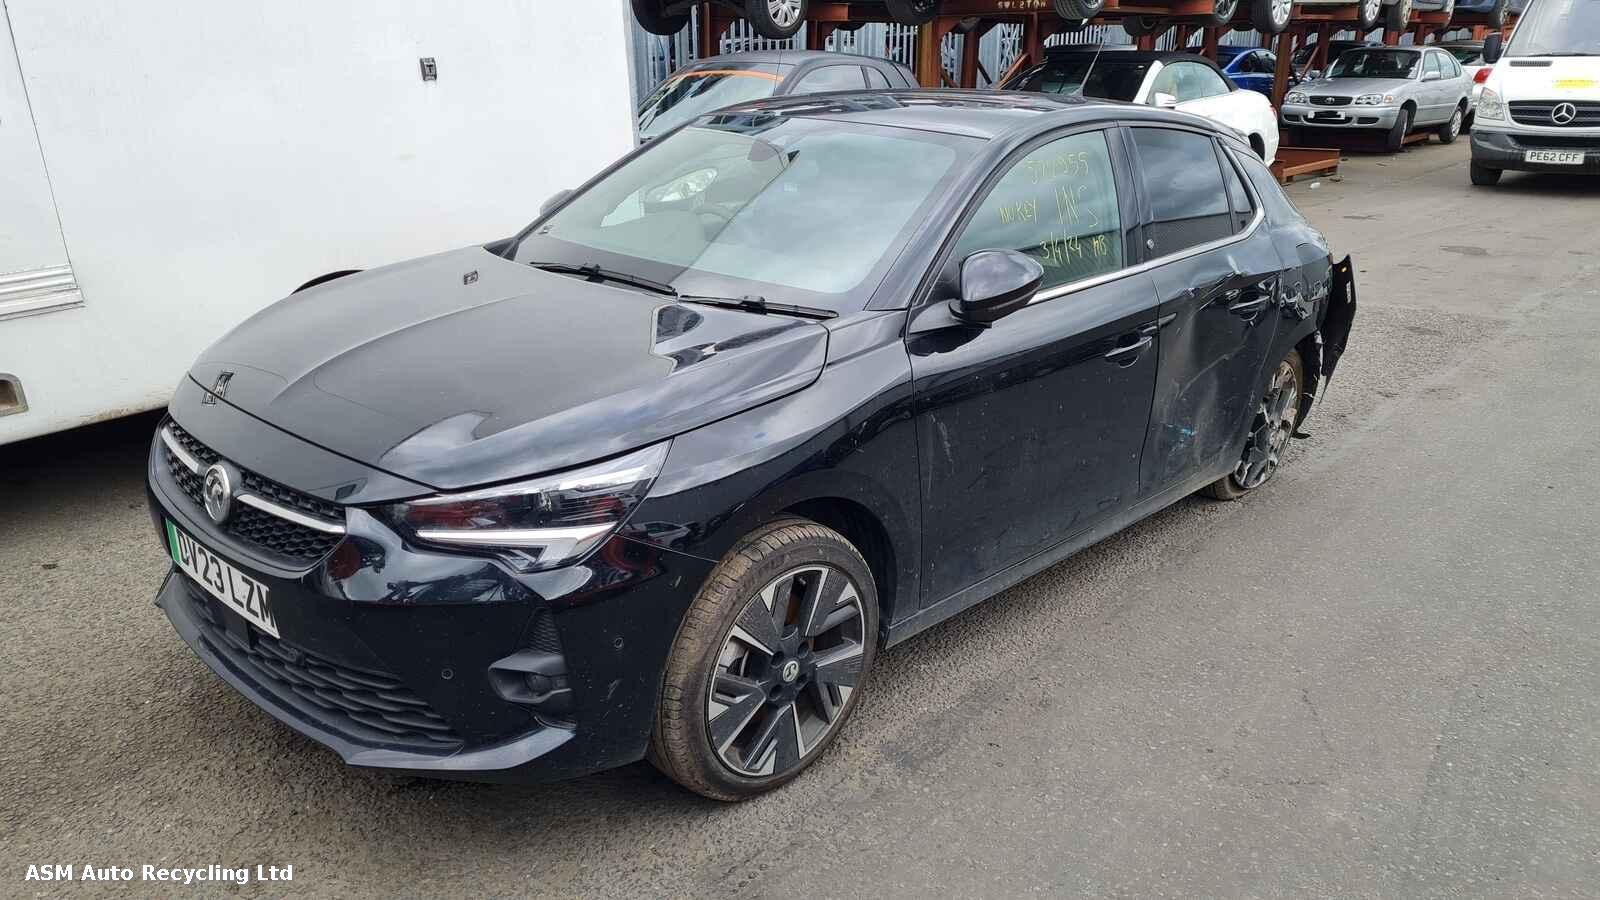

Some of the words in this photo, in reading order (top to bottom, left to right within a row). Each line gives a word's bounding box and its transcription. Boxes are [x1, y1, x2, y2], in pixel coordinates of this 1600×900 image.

[1530, 152, 1557, 162] PE62
[1558, 153, 1580, 162] CFF
[177, 528, 225, 594] DV23
[227, 566, 276, 628] LZM
